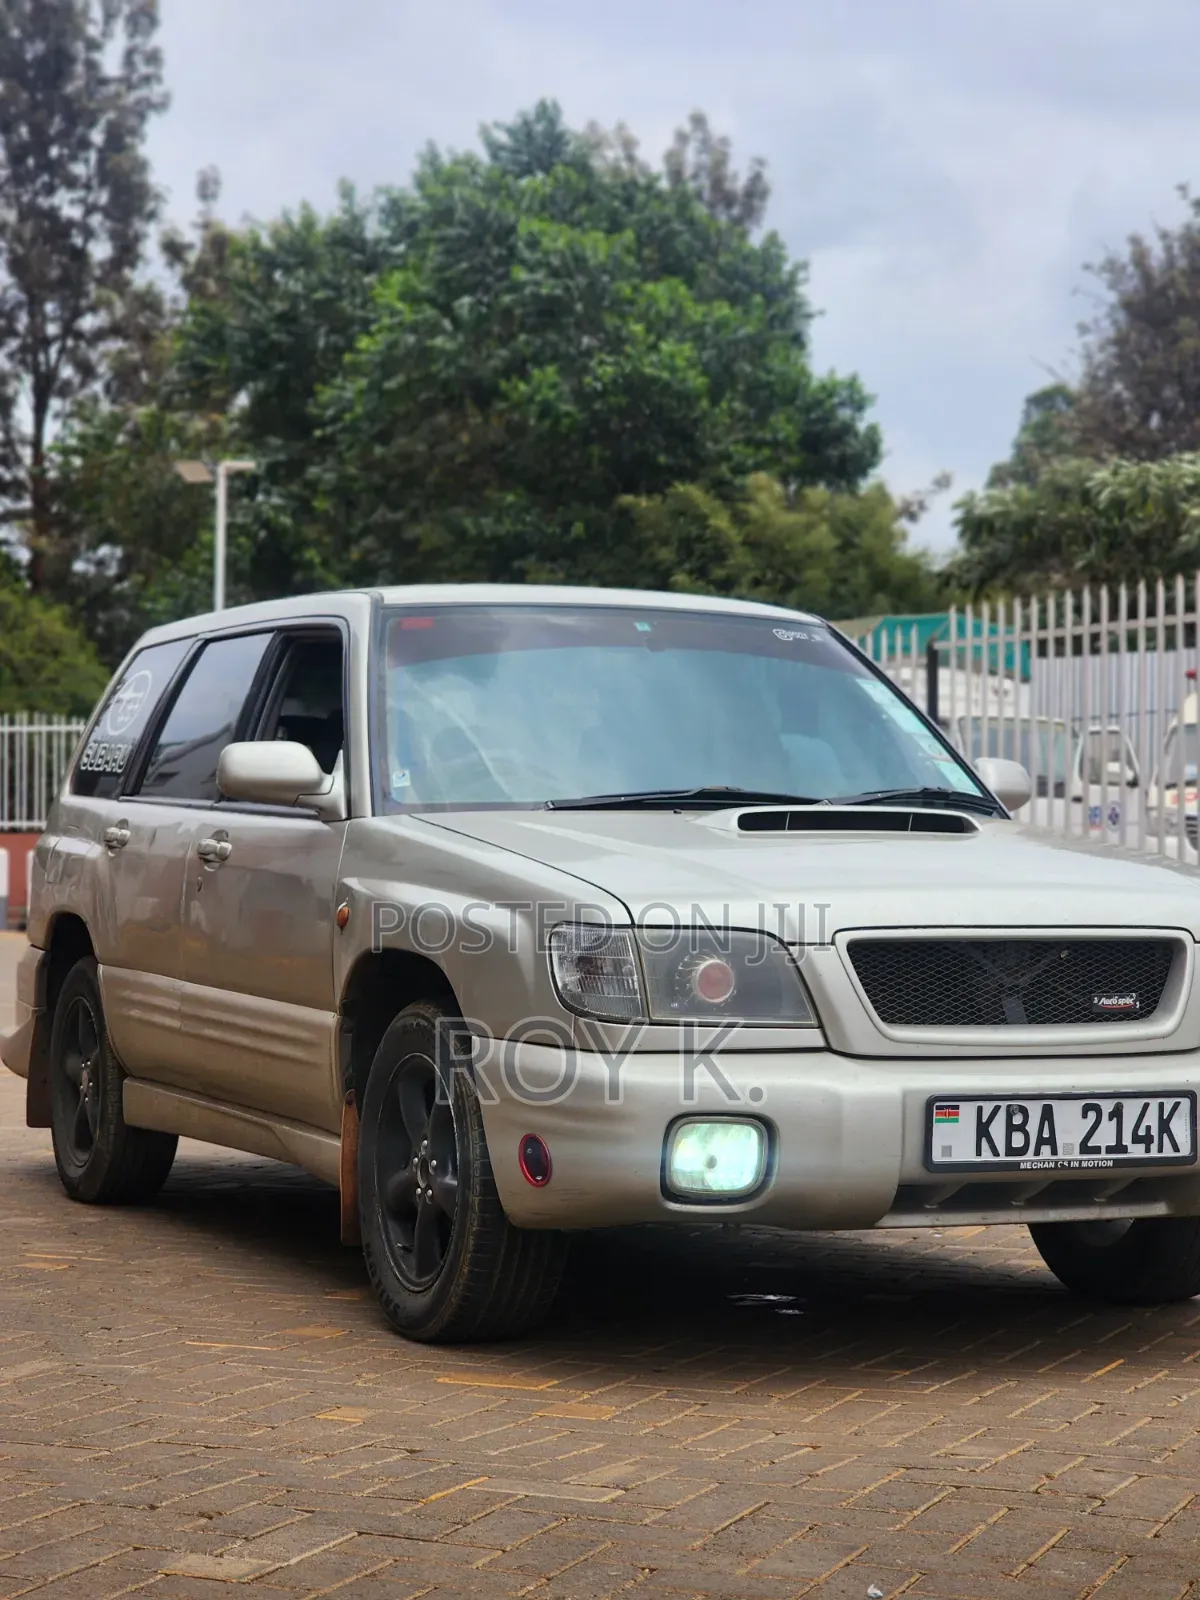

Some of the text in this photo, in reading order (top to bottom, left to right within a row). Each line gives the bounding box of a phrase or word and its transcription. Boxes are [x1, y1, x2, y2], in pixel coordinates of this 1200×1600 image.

[975, 1104, 1058, 1157] KBA
[1079, 1101, 1181, 1154] 214K
[1081, 1160, 1114, 1168] MOTION
